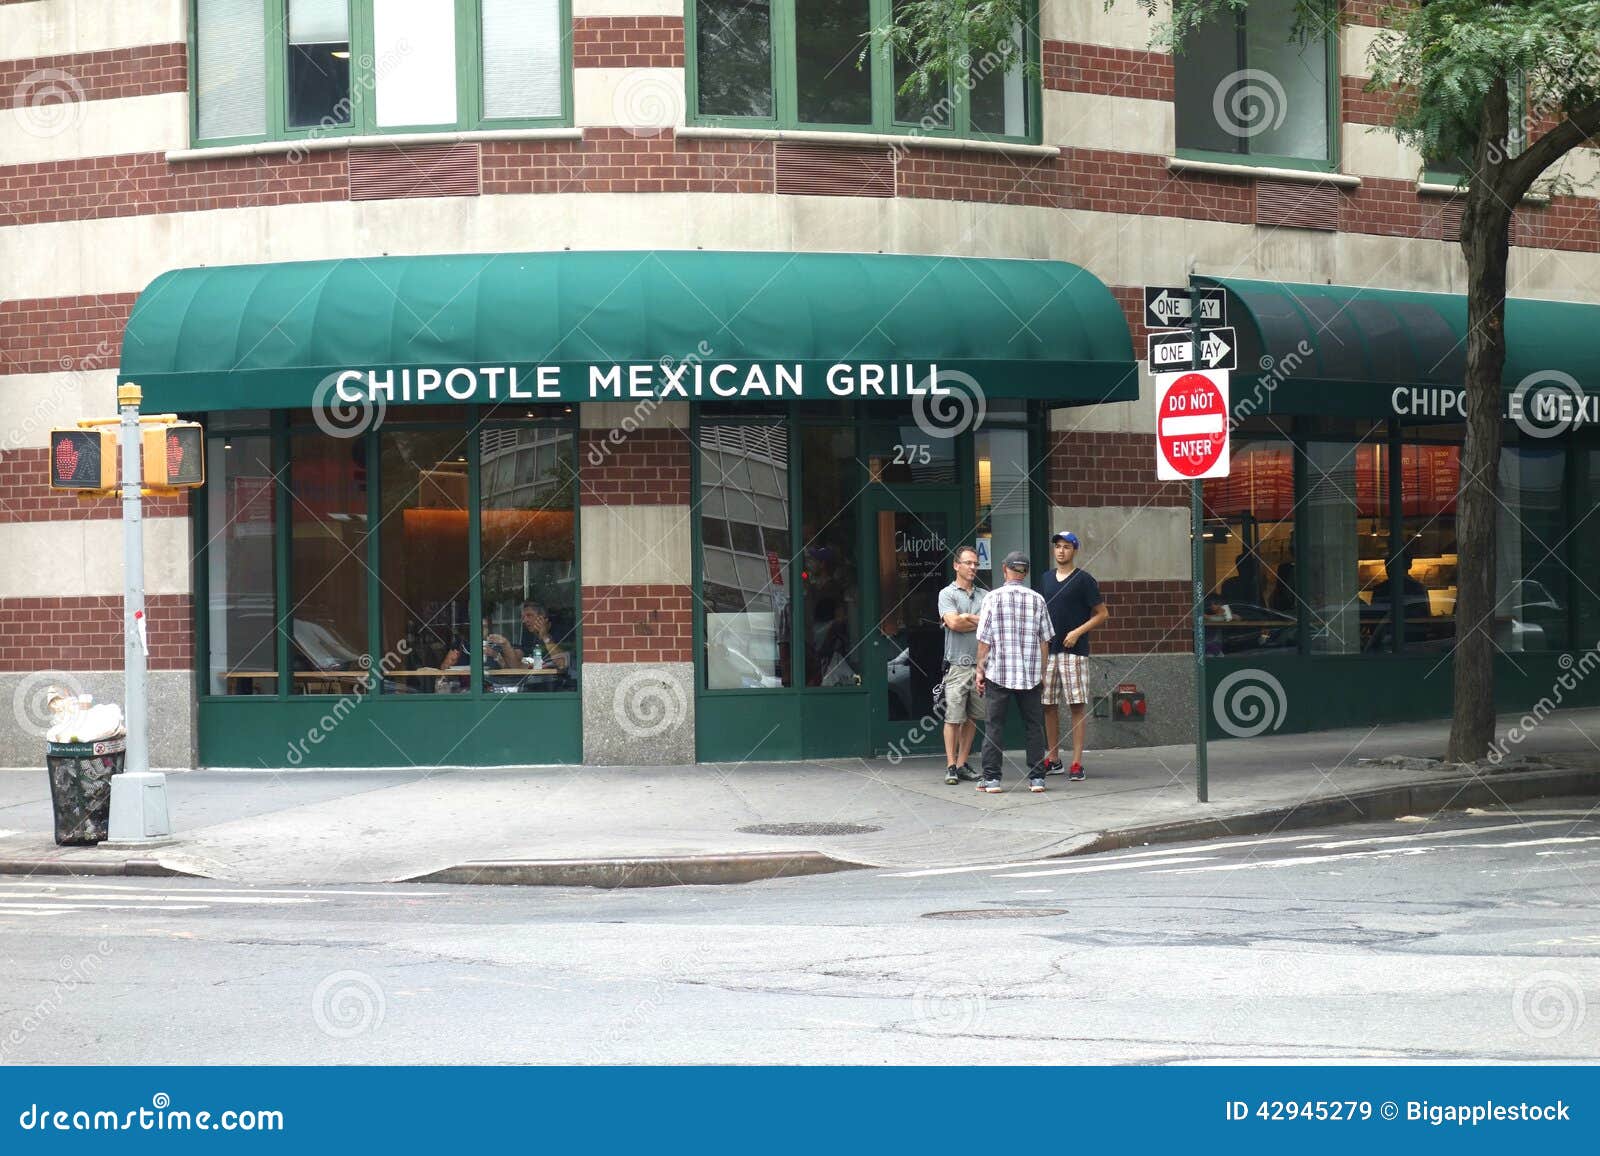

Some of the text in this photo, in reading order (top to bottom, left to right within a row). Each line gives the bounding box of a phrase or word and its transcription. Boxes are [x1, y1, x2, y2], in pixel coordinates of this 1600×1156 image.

[1158, 301, 1214, 317] ONE AY
[1161, 342, 1221, 361] ONE AY
[336, 363, 951, 401] CHIPOTLE MEXICAN GRILL
[1169, 392, 1214, 411] DO NOT
[892, 445, 931, 464] 275
[1173, 440, 1212, 457] ENTER
[895, 530, 946, 558] Chipotle
[978, 542, 988, 560] A
